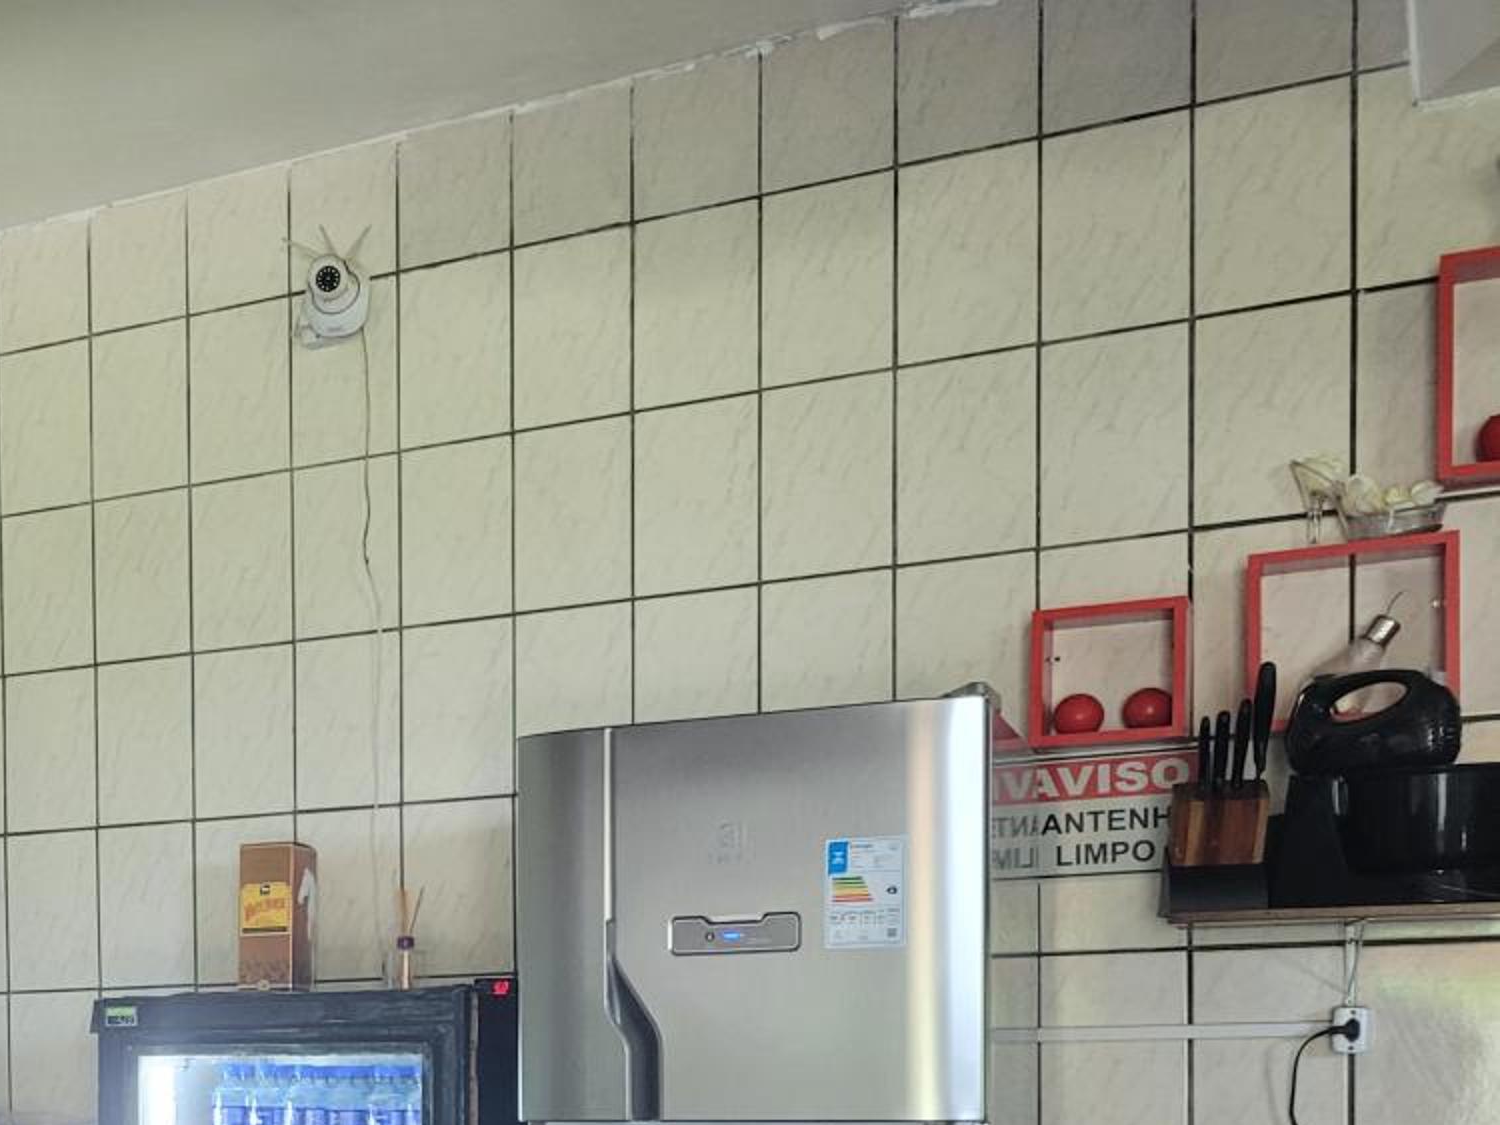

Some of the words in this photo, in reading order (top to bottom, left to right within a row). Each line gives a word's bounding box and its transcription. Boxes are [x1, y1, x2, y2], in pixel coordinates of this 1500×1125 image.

[1034, 758, 1189, 800] AVISO
[1041, 806, 1172, 836] ANTENH
[1056, 839, 1156, 867] LIMPO
